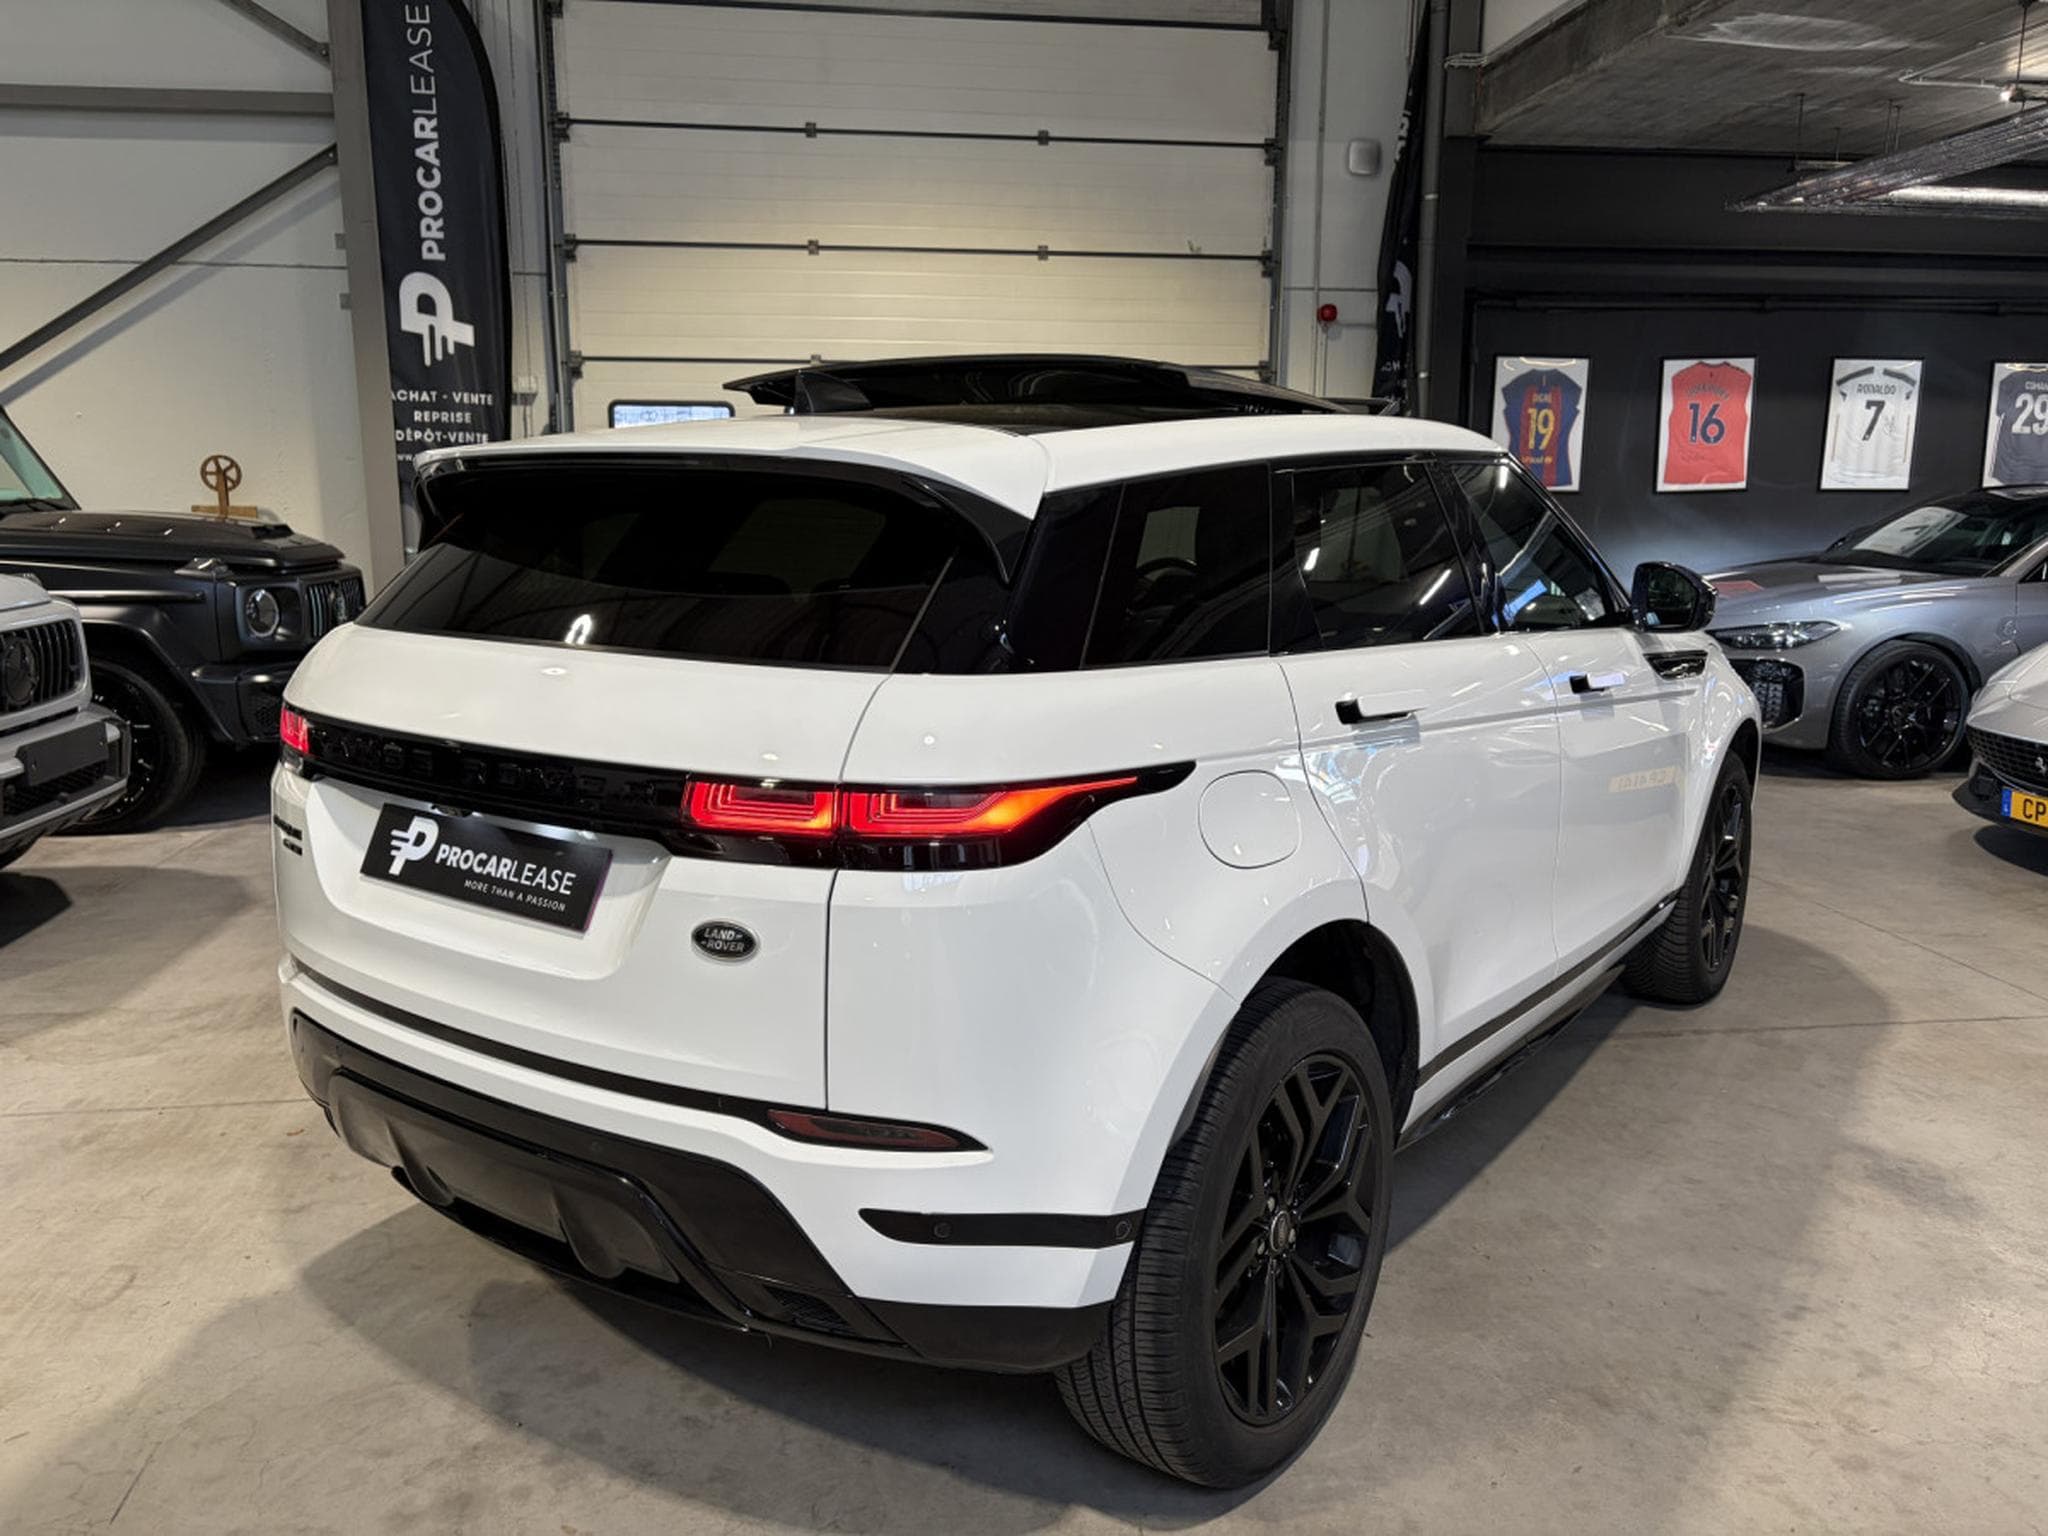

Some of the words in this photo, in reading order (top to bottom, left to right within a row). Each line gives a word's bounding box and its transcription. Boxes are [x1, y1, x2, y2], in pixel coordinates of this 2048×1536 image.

[405, 4, 446, 261] PROCARLEASE
[1857, 383, 1897, 395] RONALDO
[414, 410, 472, 424] REPRISE
[1527, 408, 1556, 451] 19
[1689, 402, 1726, 444] 16
[1862, 400, 1886, 441] 7
[2012, 393, 2048, 435] 29
[435, 843, 577, 895] PROCARLEASE
[464, 880, 488, 894] MORE
[490, 885, 515, 899] THAN
[517, 892, 524, 901] A
[526, 894, 566, 912] PASSION
